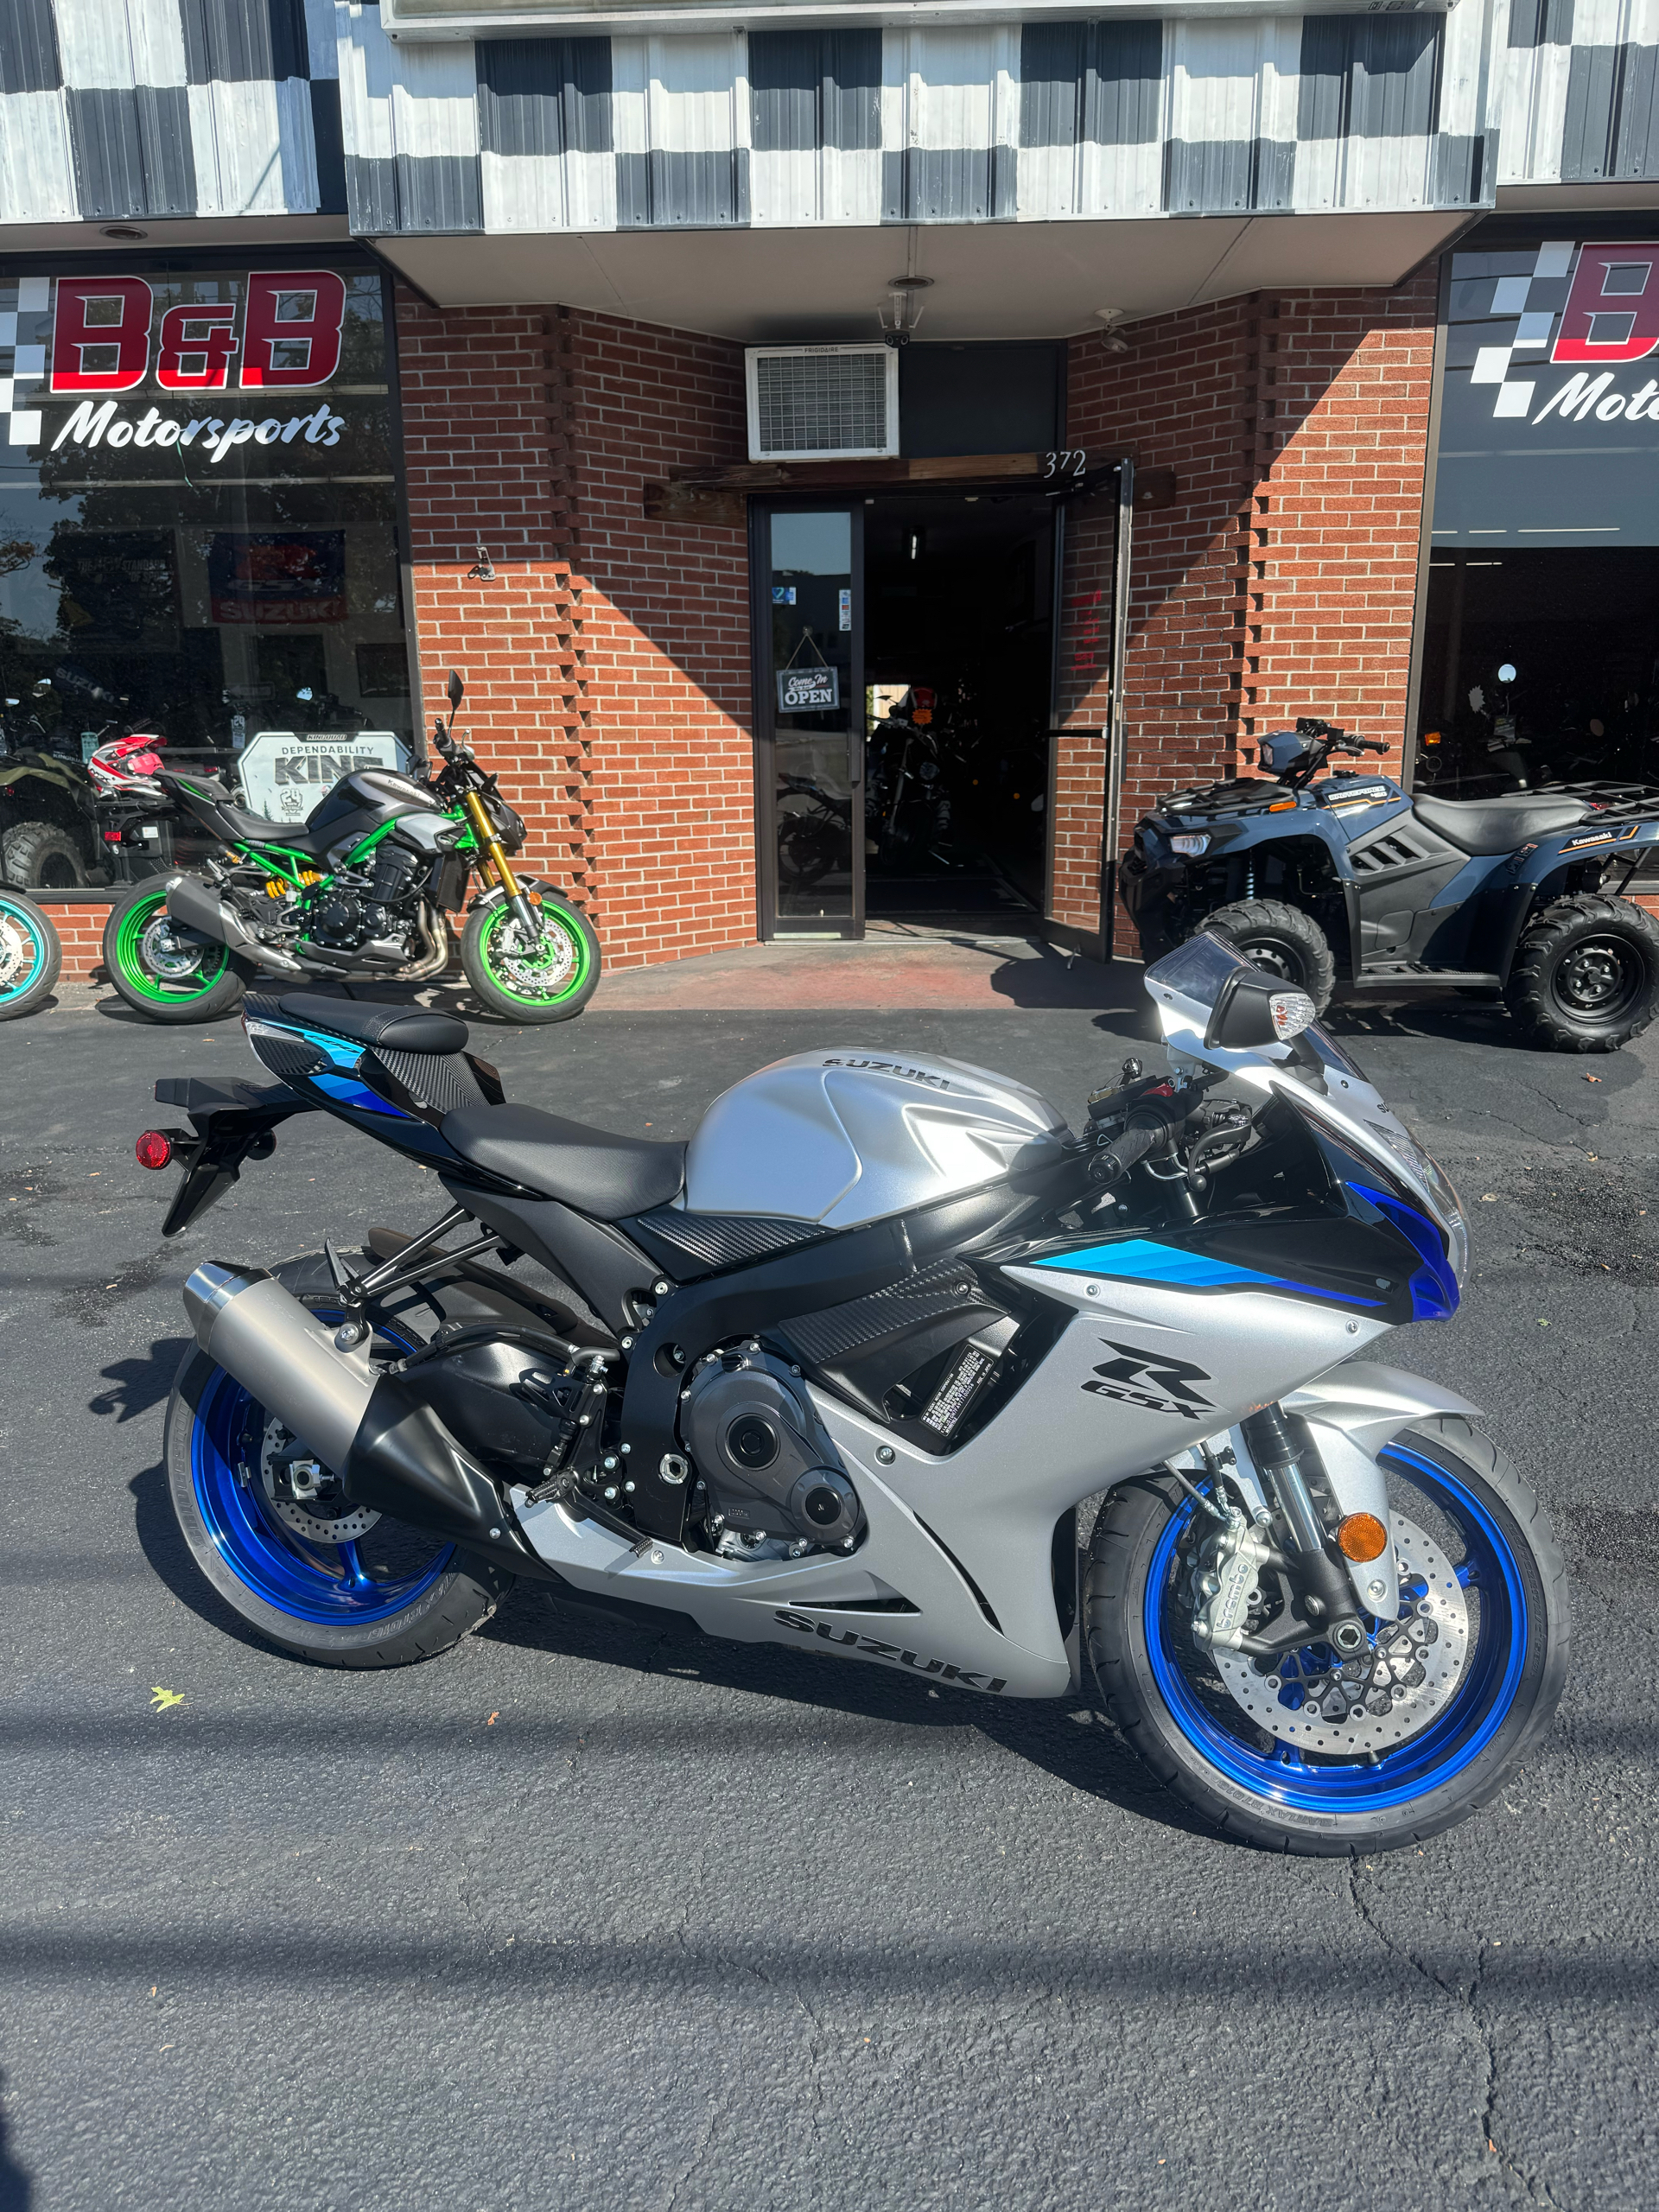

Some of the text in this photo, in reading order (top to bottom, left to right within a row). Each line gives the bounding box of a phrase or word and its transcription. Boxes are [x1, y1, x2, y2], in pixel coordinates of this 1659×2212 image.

[50, 270, 347, 393] B&B
[51, 400, 346, 463] Motorsports
[1043, 449, 1086, 479] 372
[218, 601, 340, 620] SUZUKI
[787, 674, 829, 688] Come In
[784, 689, 833, 706] OPEN
[281, 745, 375, 755] DEPENDABILITY
[387, 778, 421, 798] Kawasaki
[1571, 831, 1613, 846] Kawasaki
[822, 1058, 950, 1090] SUZUKI
[1080, 1380, 1216, 1421] GSX
[1216, 1563, 1249, 1629] brembo
[772, 1609, 1008, 1694] SUZUKI
